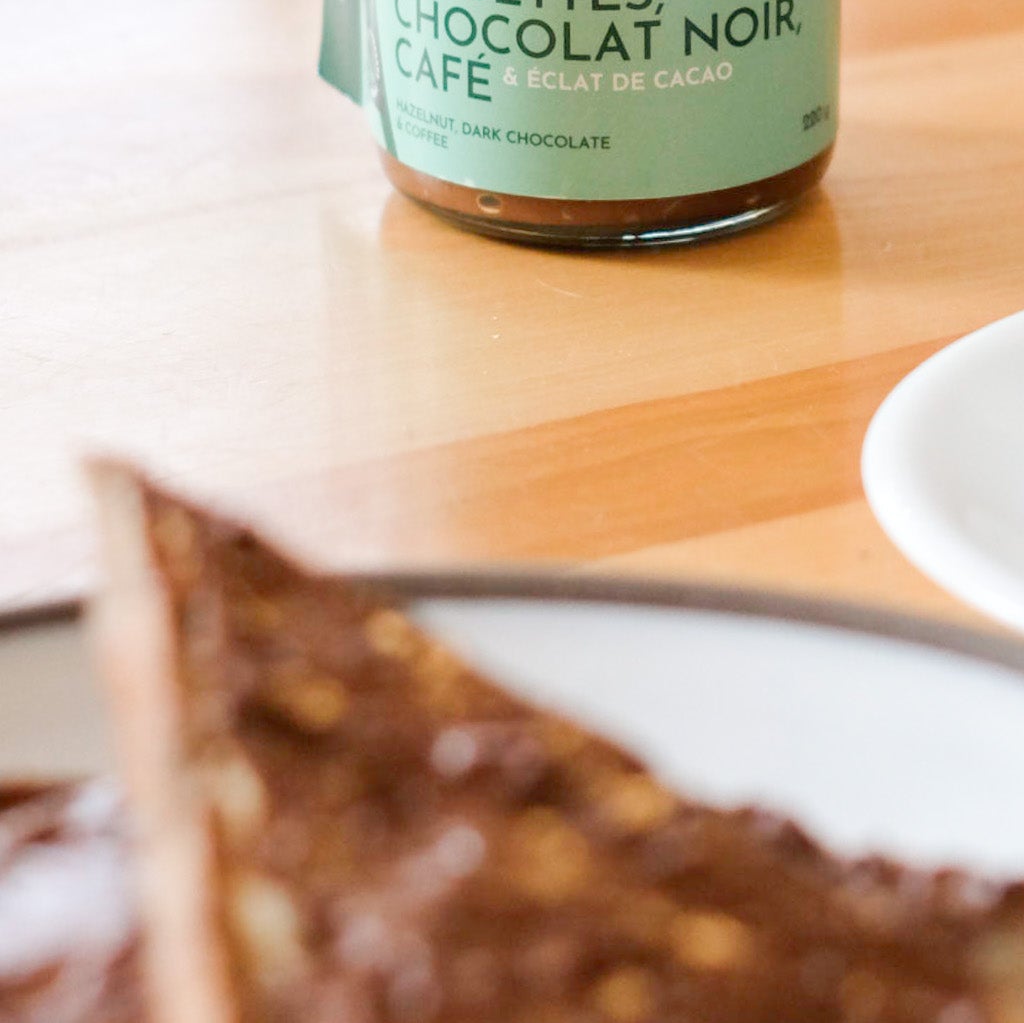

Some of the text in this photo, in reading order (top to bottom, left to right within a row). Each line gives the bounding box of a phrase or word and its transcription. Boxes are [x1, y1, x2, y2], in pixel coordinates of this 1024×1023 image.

[395, 38, 733, 102] CAFÉ & ÉCLAT DE CACAO
[405, 121, 448, 149] COFFEE
[462, 121, 500, 141] DARK
[506, 130, 611, 149] CHOCOLATE
